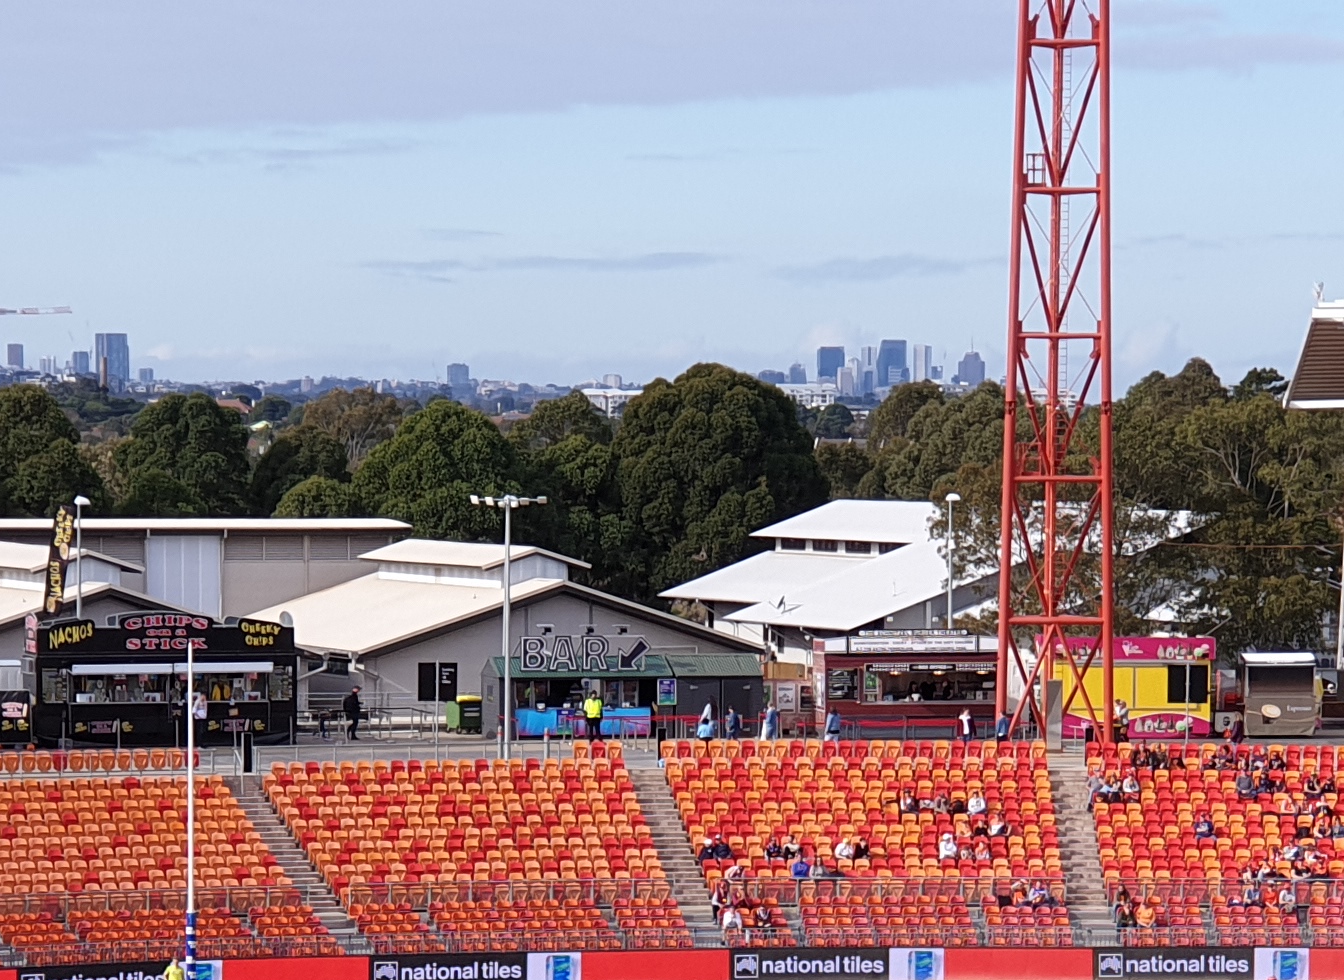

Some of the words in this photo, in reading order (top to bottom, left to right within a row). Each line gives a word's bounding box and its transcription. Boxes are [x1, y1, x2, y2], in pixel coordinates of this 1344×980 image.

[123, 614, 209, 630] CHIPS
[49, 622, 93, 650] NACHOS
[125, 637, 209, 650] STICK
[520, 635, 610, 671] BAR
[401, 961, 479, 980] national
[481, 961, 522, 979] tiles
[761, 956, 840, 974] national
[842, 955, 885, 973] tiles
[1125, 954, 1205, 973] national
[1207, 954, 1249, 972] tiles
